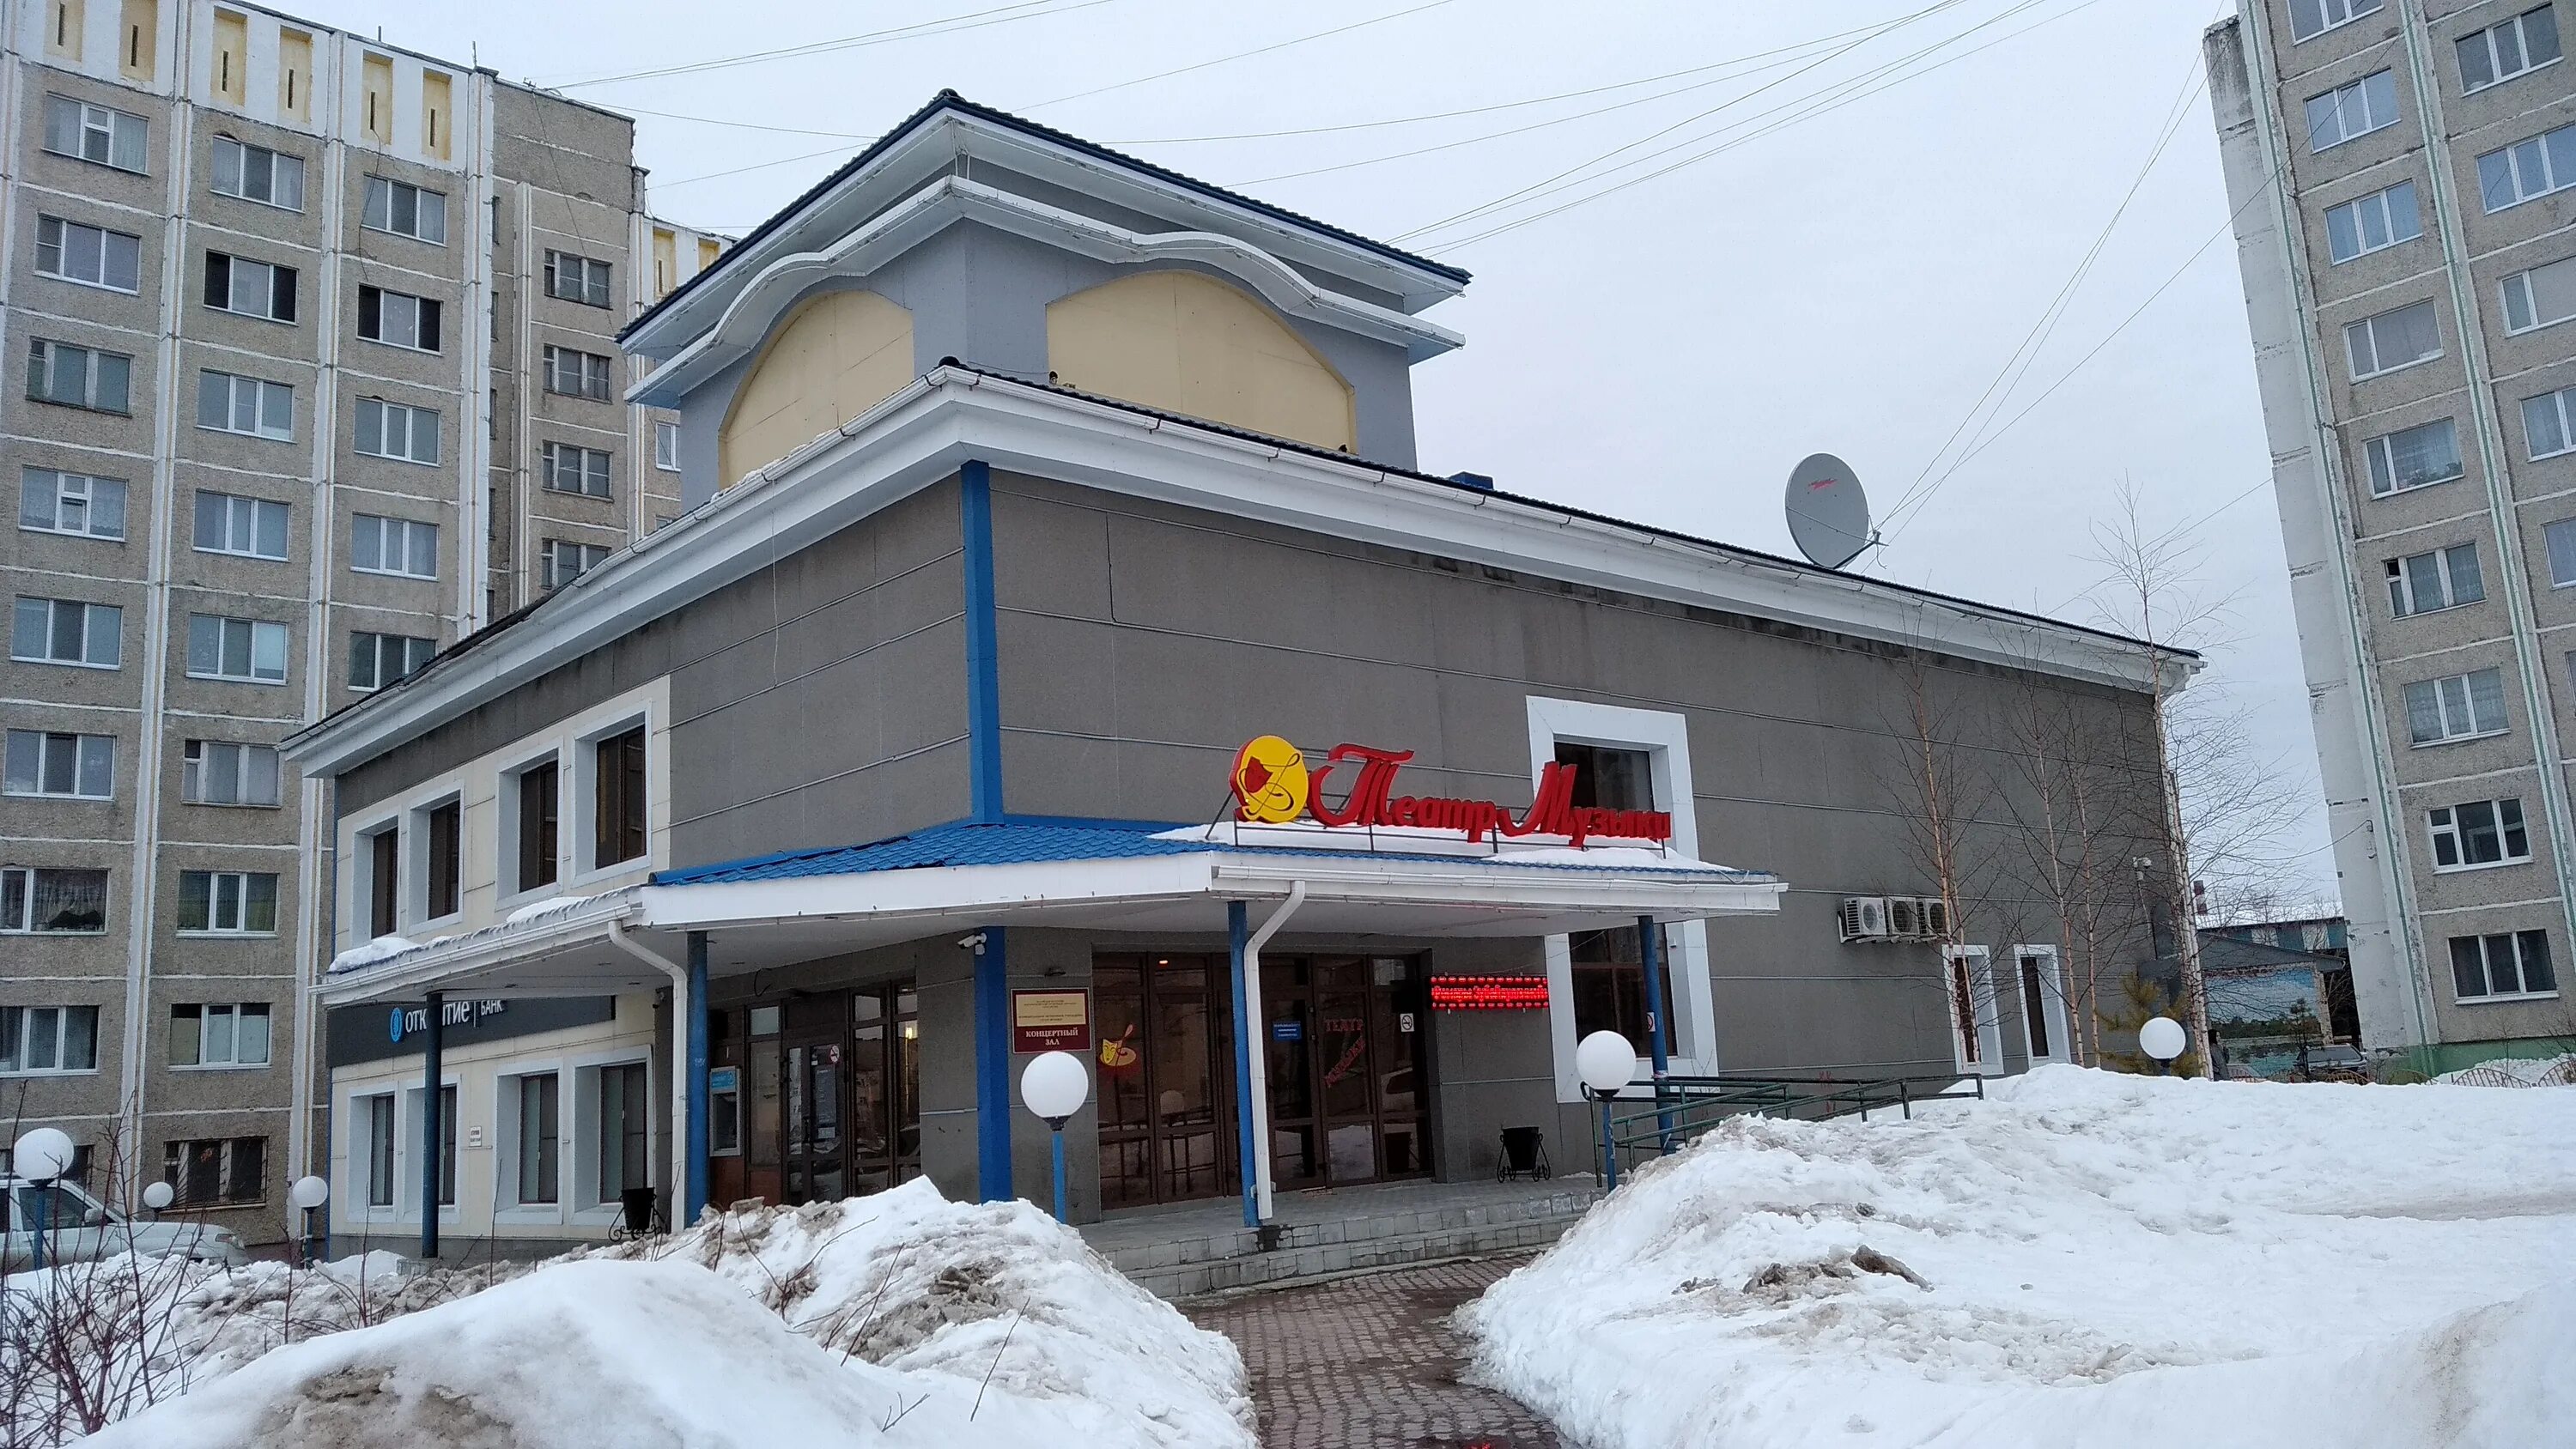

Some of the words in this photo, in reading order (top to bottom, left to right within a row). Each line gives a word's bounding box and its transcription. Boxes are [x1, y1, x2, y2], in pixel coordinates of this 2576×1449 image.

[1306, 743, 1495, 844] Театр
[1496, 761, 1672, 847] Музыки
[405, 1002, 470, 1033] ОТКТИЕ
[481, 999, 503, 1016] БАНК
[1025, 1027, 1078, 1038] КОНЦЕРТНЫЙ
